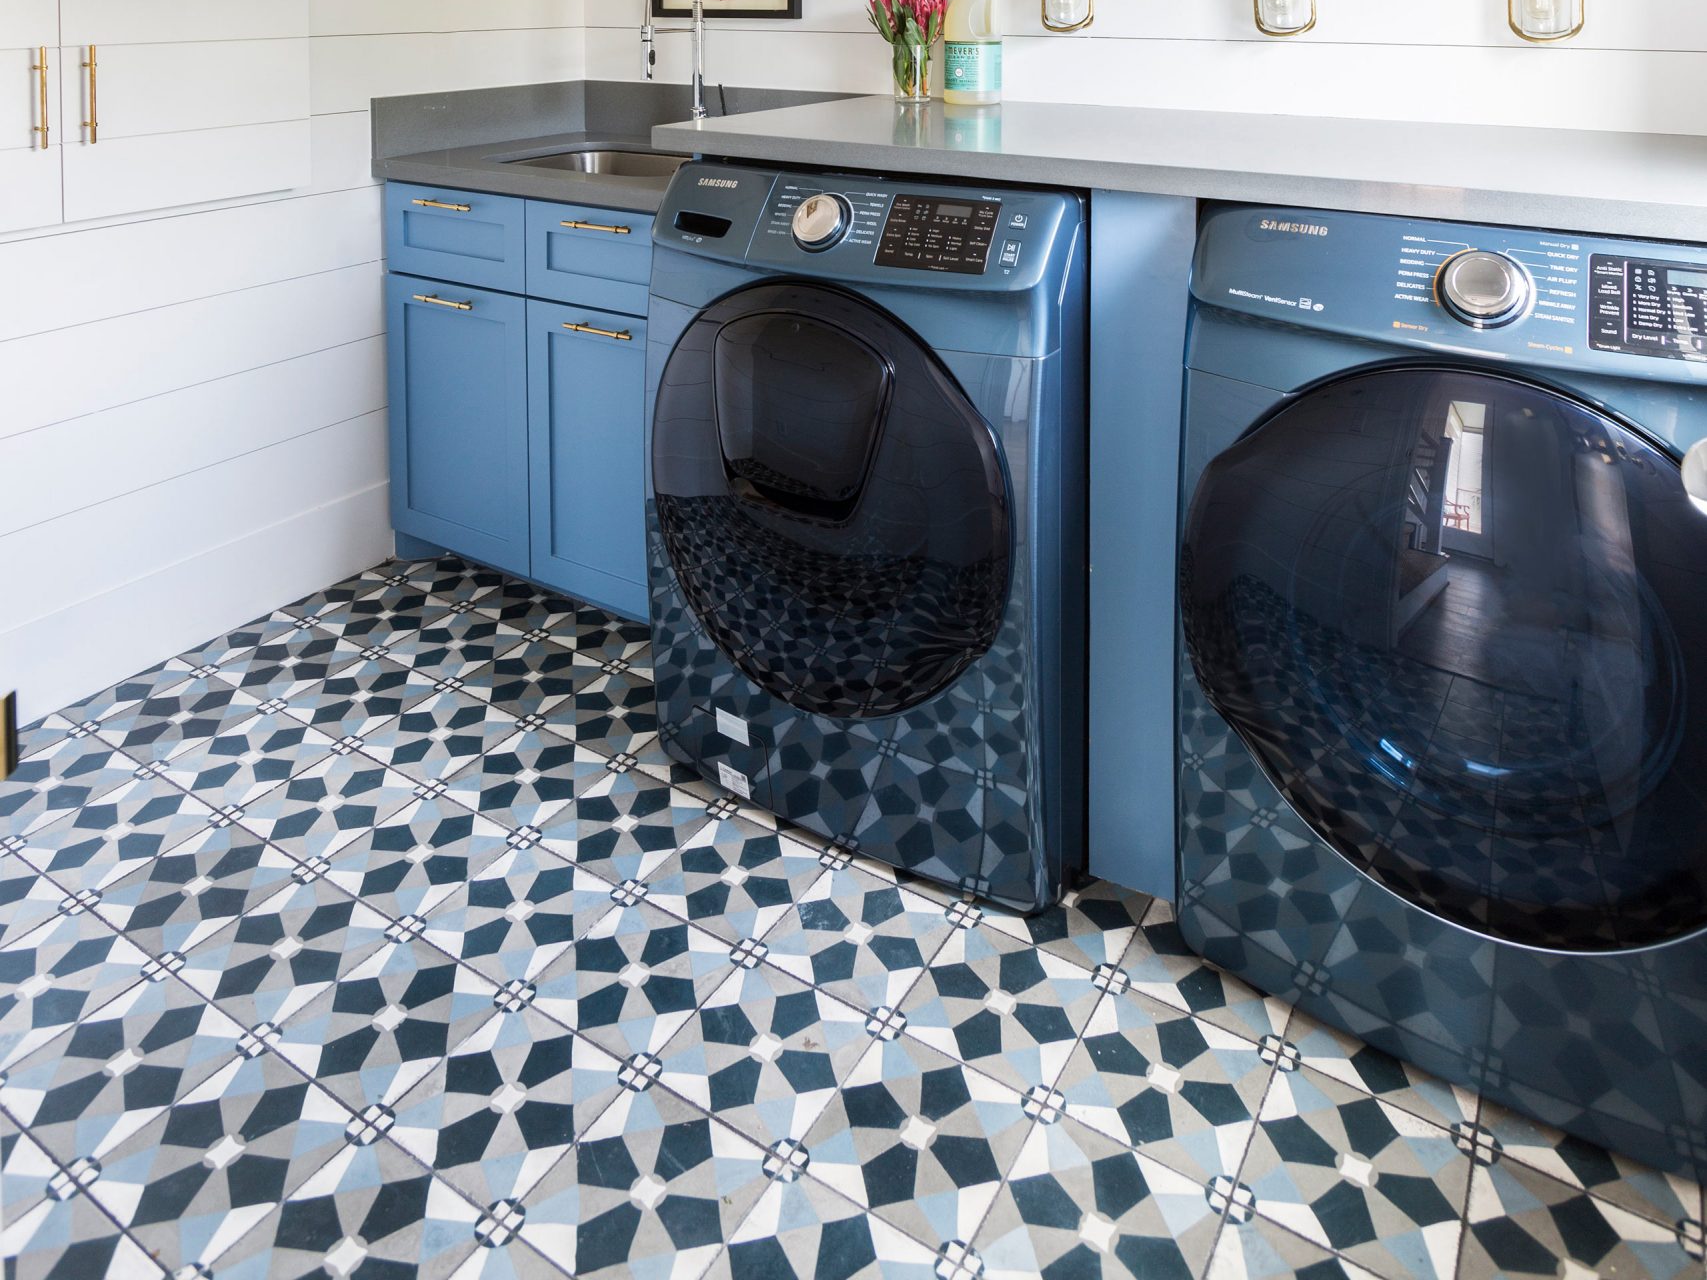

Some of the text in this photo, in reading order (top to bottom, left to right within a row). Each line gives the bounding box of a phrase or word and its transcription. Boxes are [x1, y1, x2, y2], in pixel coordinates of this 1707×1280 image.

[697, 177, 738, 189] SAMSUNG
[1260, 219, 1328, 236] SAMSUNG
[1402, 235, 1427, 243] NORMAL
[1401, 247, 1420, 255] HEAVY
[1546, 251, 1566, 259] QUICK
[1400, 258, 1425, 266] BEDDING
[1549, 264, 1565, 272] TIME
[1398, 269, 1430, 279] PERM PRESS
[1396, 281, 1426, 290] DELICATES
[1549, 288, 1577, 298] REFRESH
[1394, 293, 1429, 303] ACTIVE WEAR
